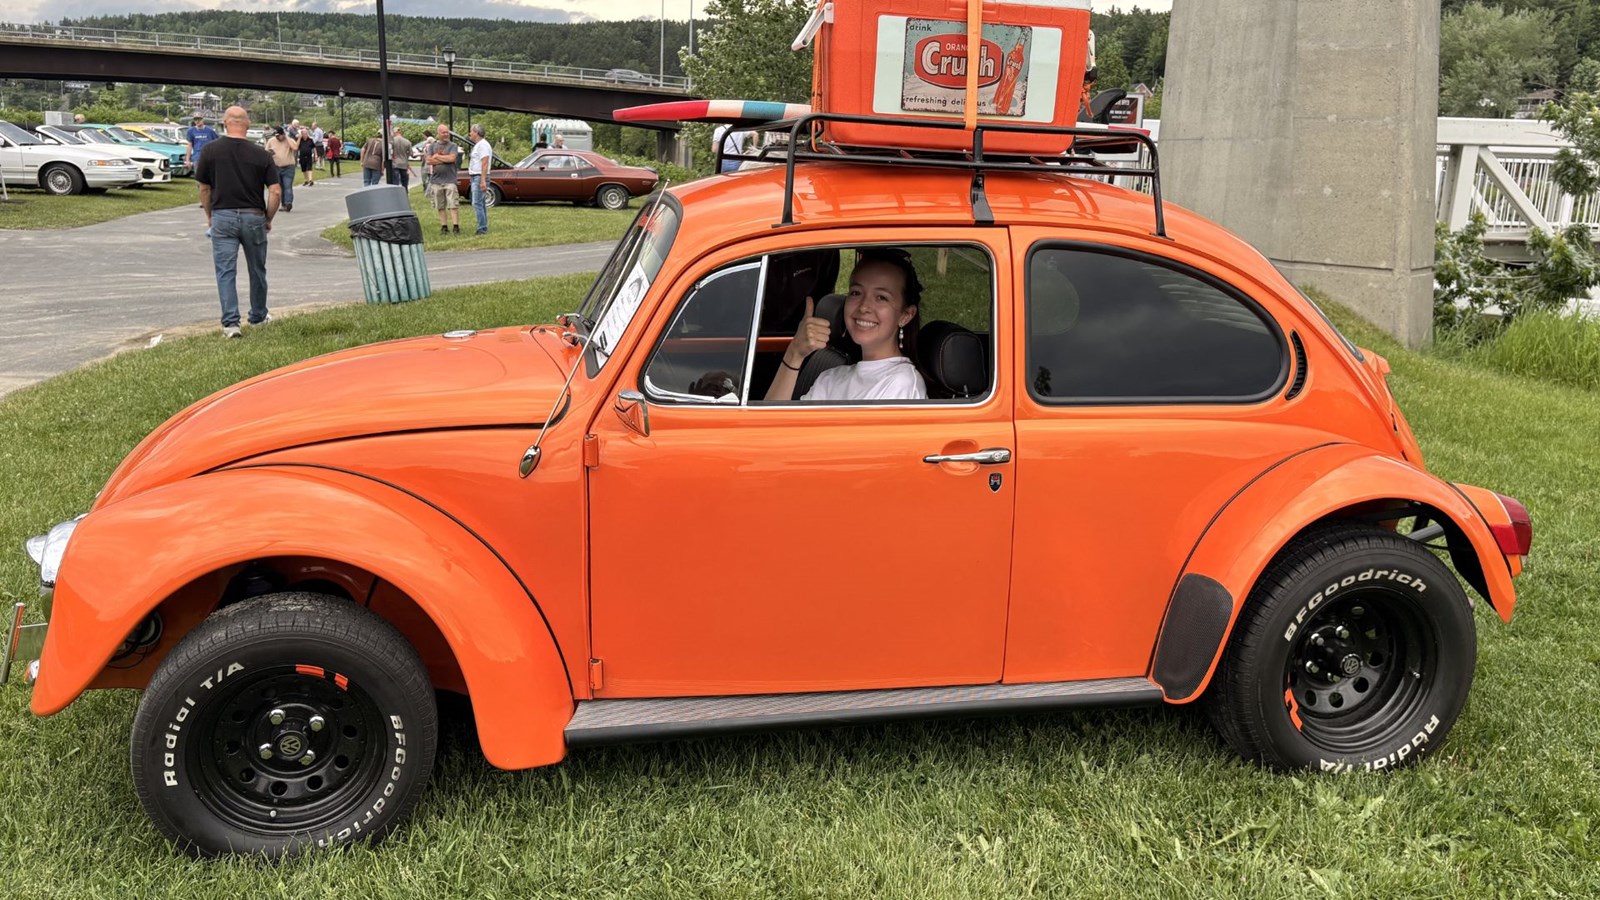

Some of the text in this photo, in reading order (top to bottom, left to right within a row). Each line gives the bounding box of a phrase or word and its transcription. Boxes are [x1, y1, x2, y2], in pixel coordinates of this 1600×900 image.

[909, 24, 932, 32] drink
[921, 40, 996, 78] Cruh
[945, 42, 967, 51] ORAN
[905, 95, 987, 107] refreshing delius
[1284, 568, 1427, 642] BFGoodrich
[163, 661, 245, 786] Radial T/A
